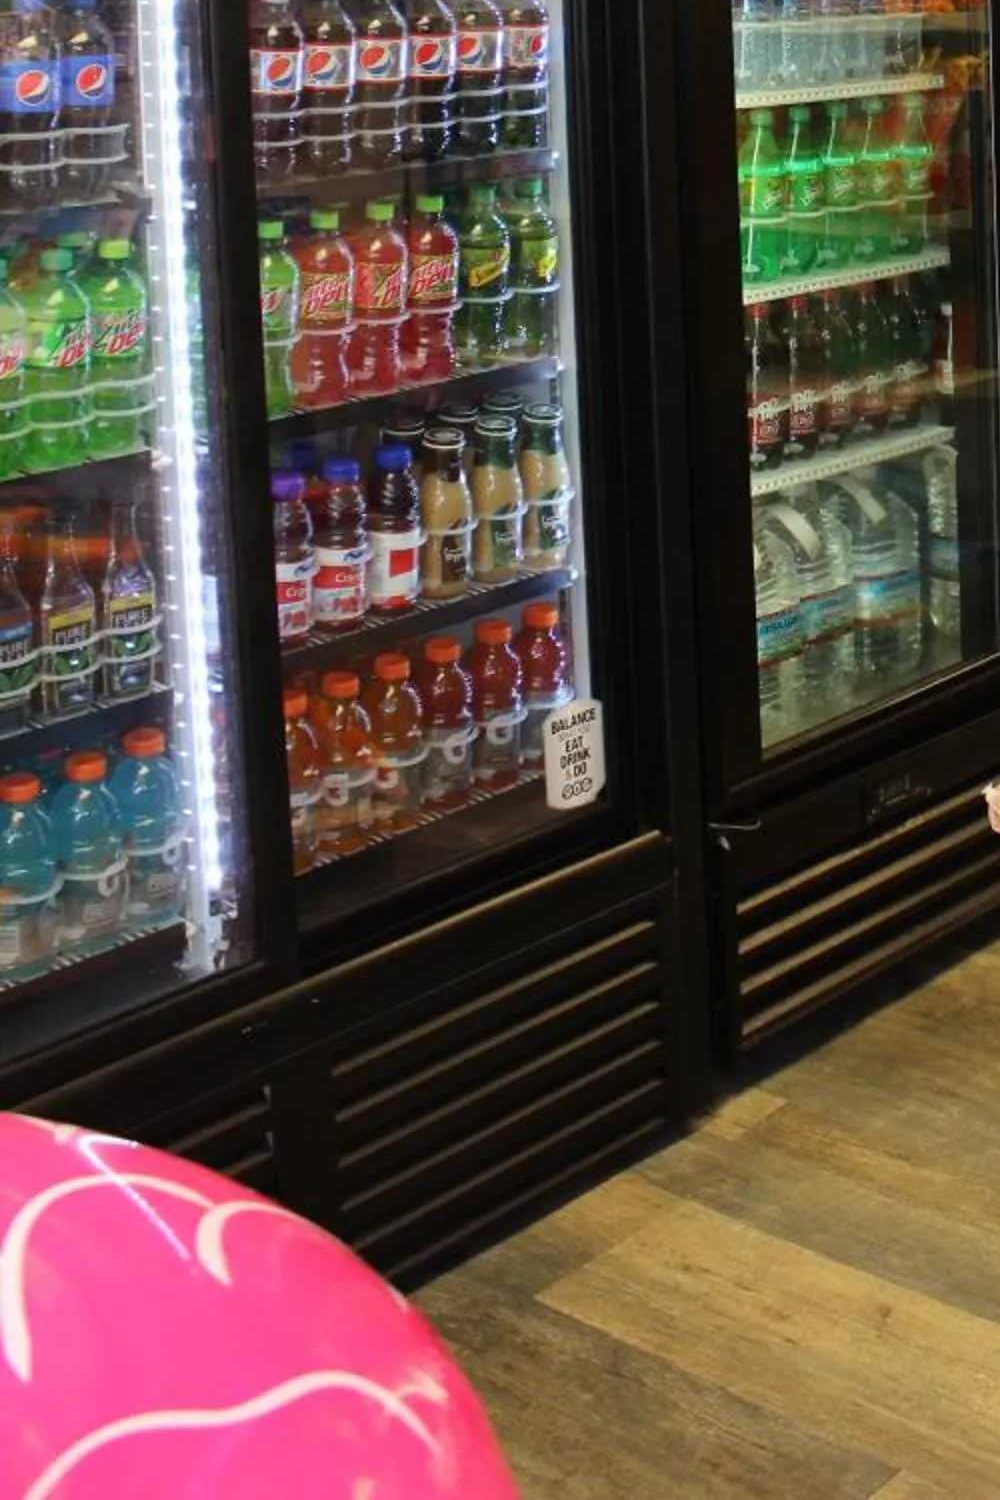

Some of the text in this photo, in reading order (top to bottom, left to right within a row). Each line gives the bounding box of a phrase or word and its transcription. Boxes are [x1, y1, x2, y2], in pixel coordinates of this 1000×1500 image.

[551, 707, 596, 735] BALANCE
[565, 735, 583, 753] EAT
[573, 761, 587, 777] DO
